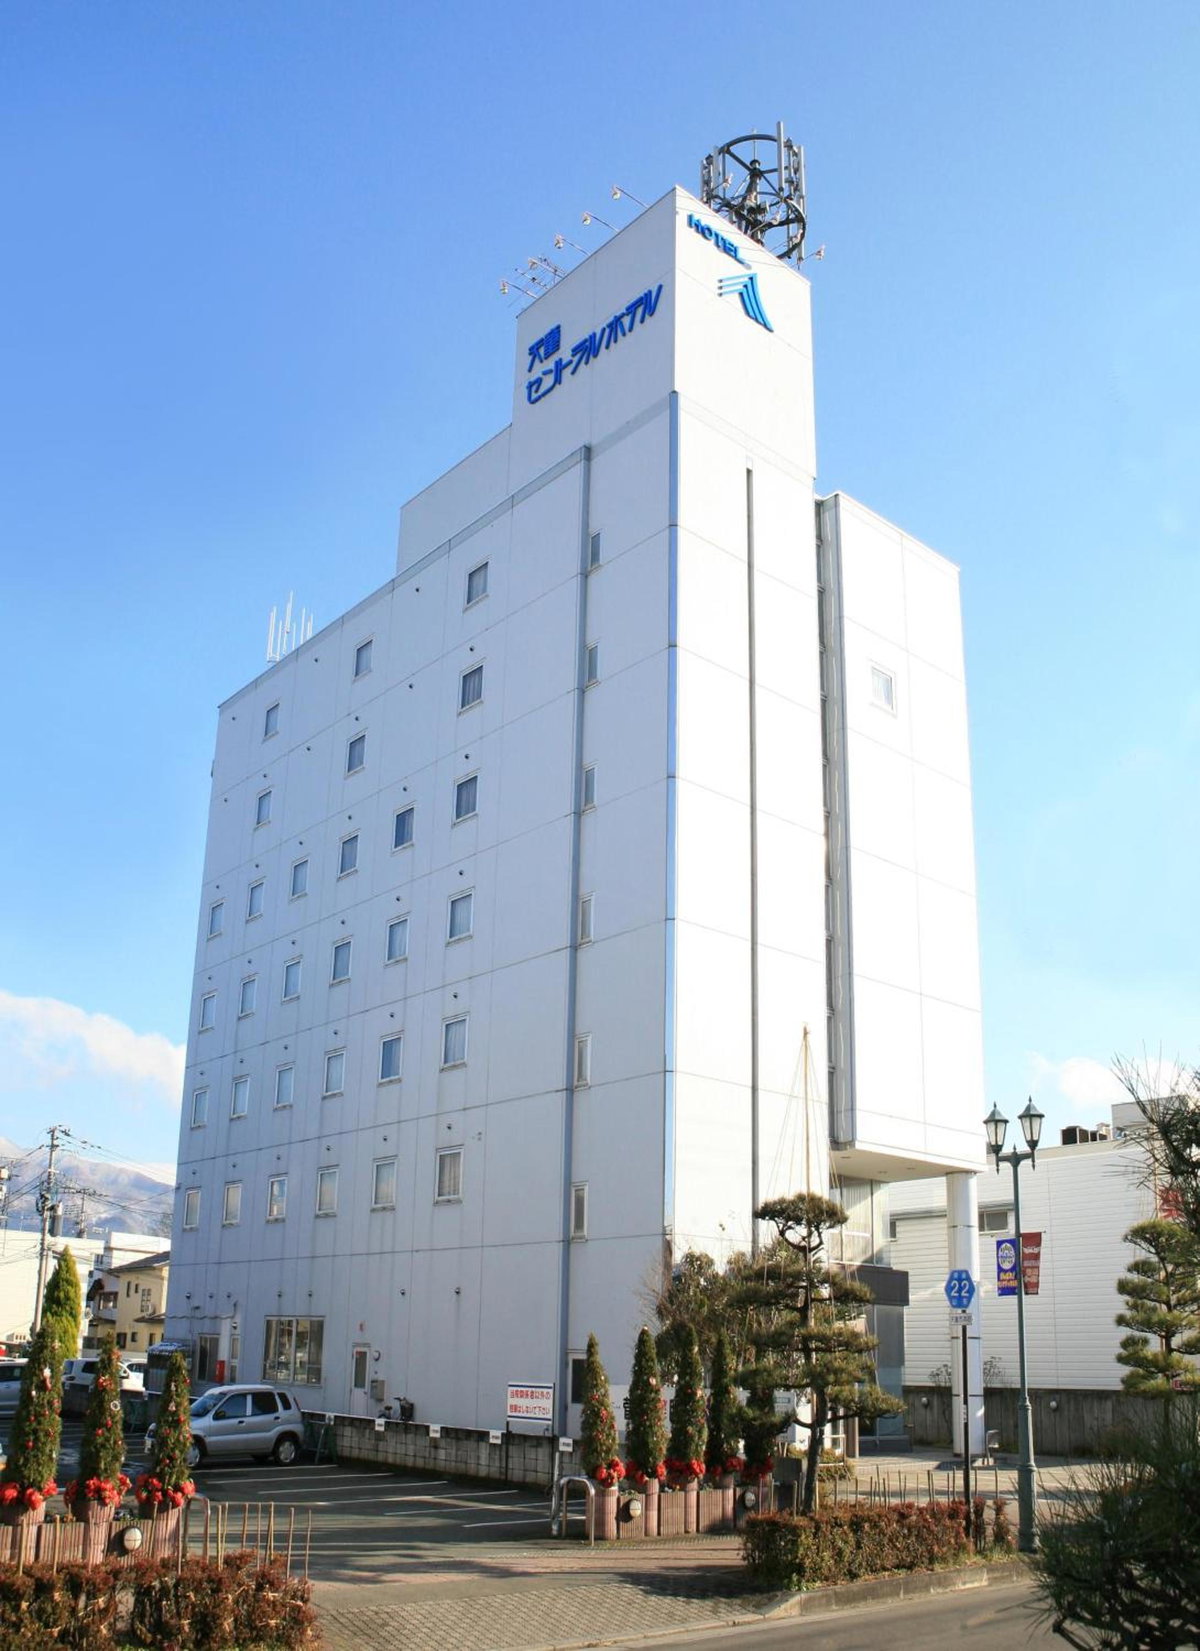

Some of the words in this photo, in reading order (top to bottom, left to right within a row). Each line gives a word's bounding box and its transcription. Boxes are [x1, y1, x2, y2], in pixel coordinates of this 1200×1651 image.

[687, 212, 752, 270] HOTEL
[525, 283, 664, 405] セントラルホテル
[950, 1280, 970, 1297] 22
